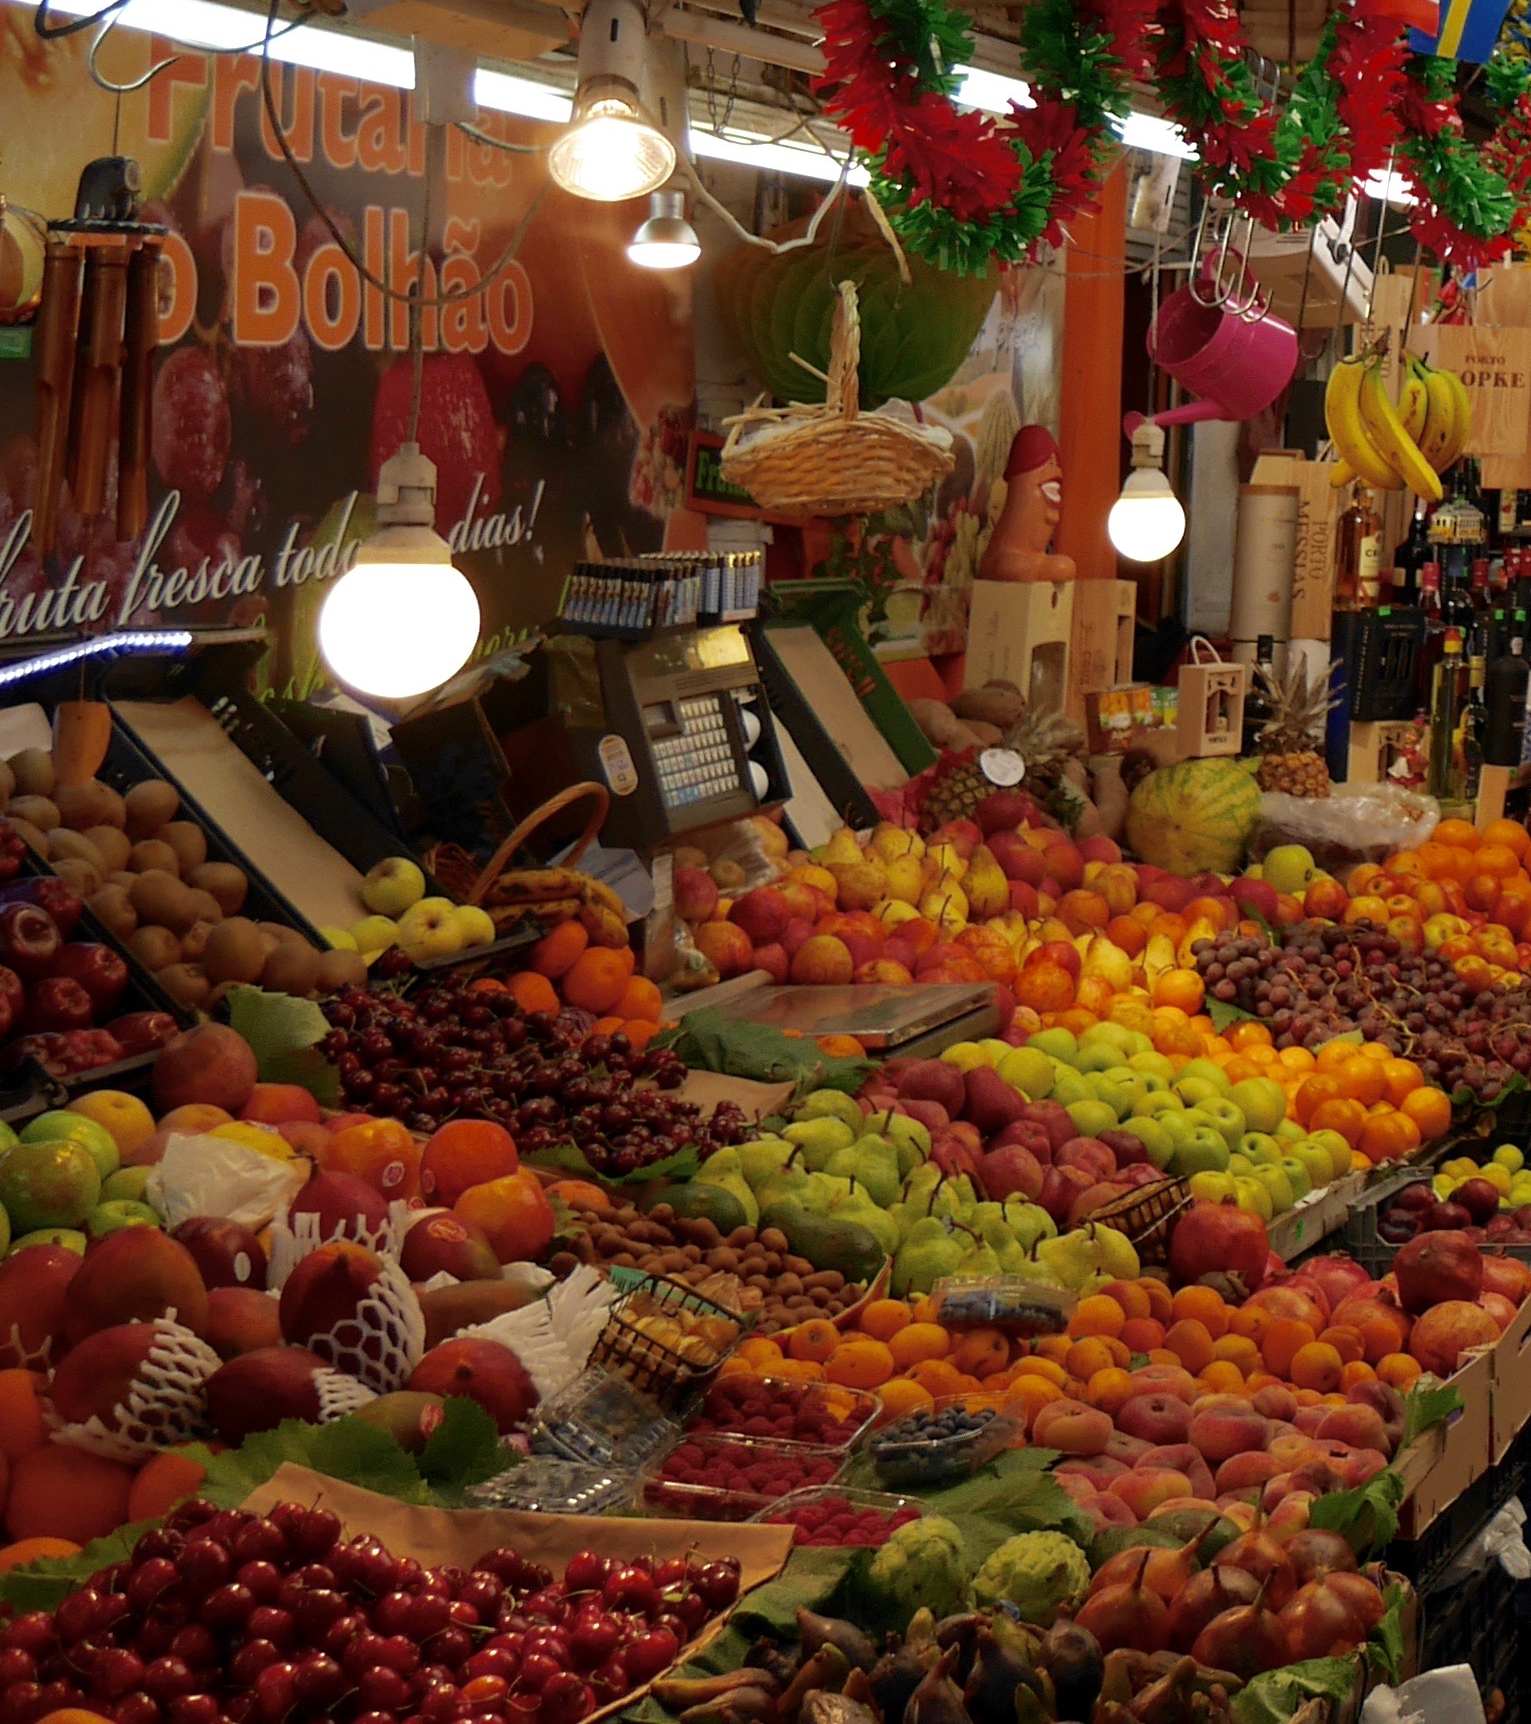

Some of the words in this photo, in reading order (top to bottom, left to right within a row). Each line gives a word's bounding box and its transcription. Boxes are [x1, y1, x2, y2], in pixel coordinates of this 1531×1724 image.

[232, 190, 534, 355] Bolhão
[1450, 370, 1525, 388] OPKE
[117, 489, 263, 626] fresca
[448, 472, 546, 555] dias!
[1309, 520, 1329, 581] PORTO
